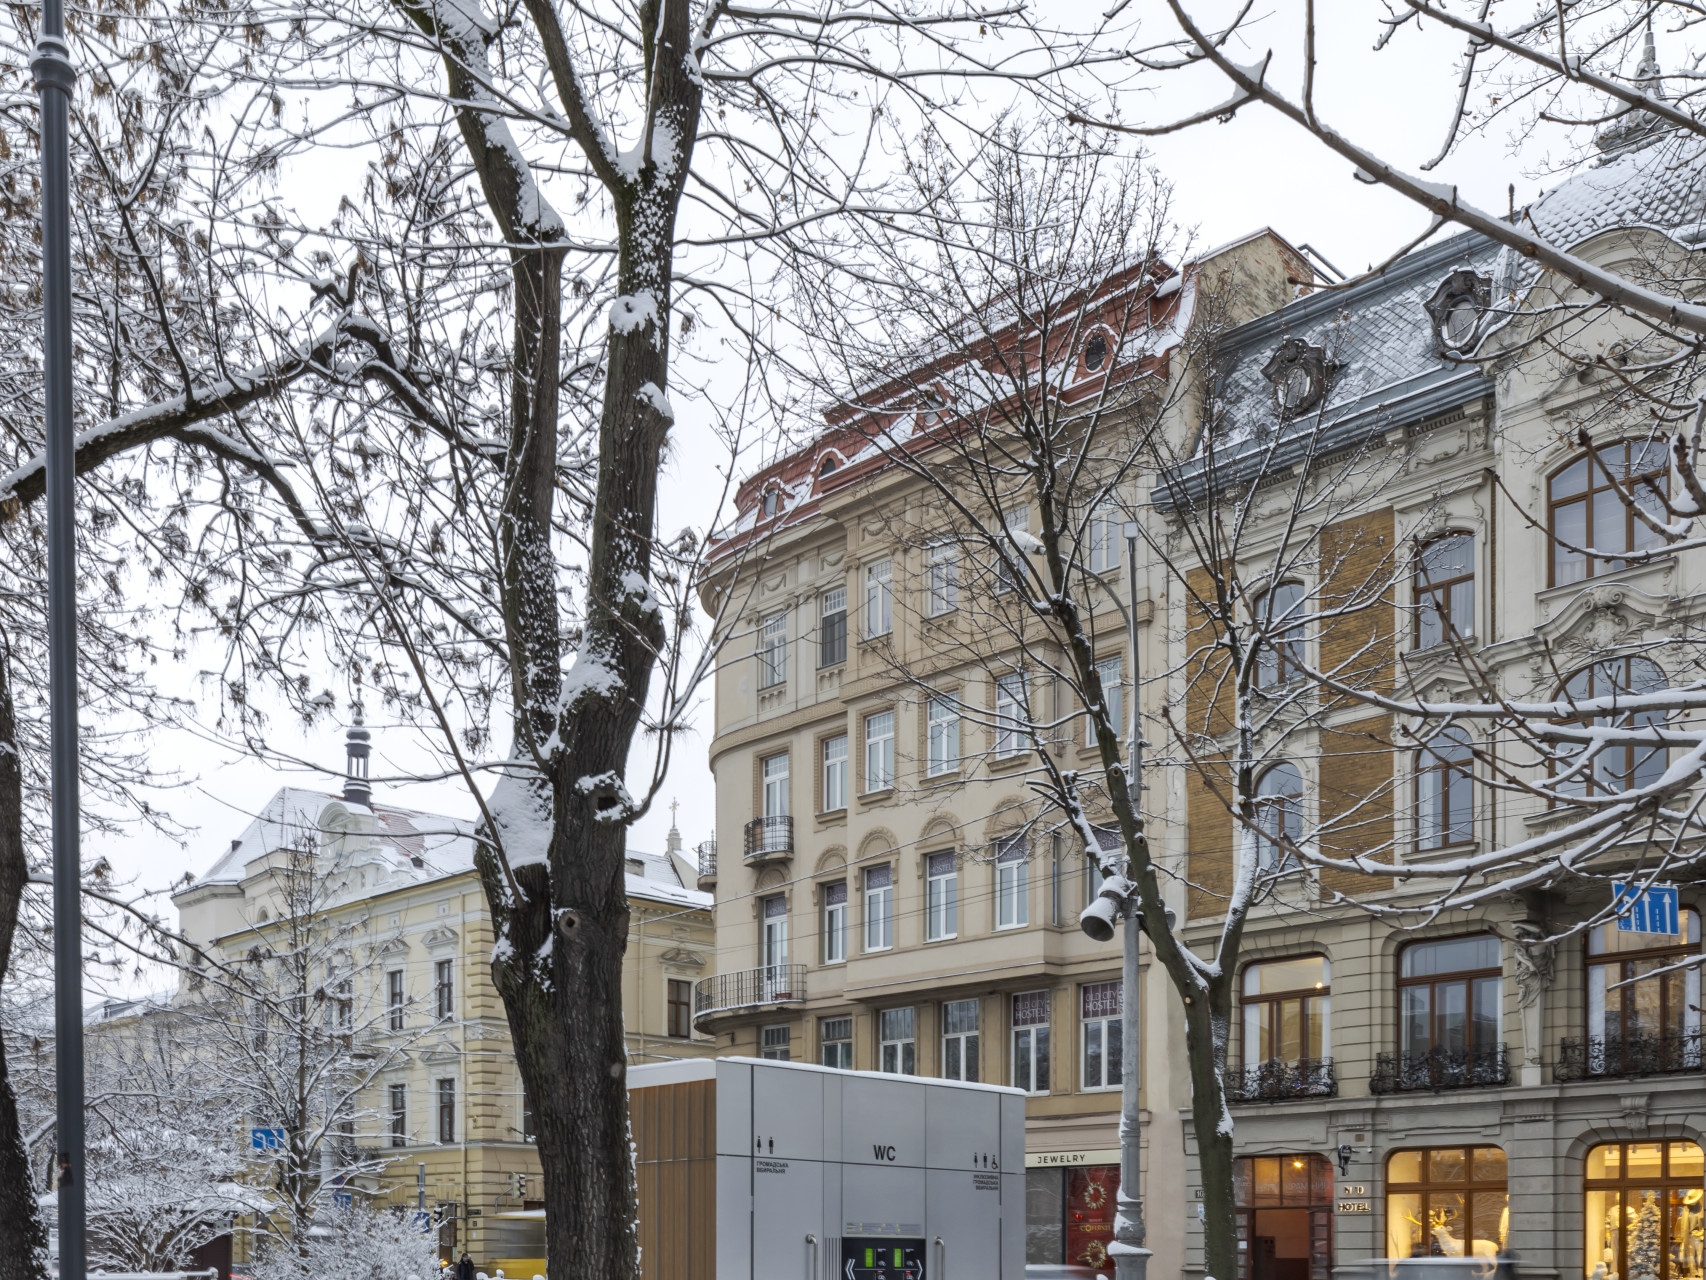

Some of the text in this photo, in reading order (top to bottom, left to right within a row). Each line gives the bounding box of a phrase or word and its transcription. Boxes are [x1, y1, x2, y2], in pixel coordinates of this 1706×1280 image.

[1086, 992, 1100, 1001] OLD
[1016, 1002, 1029, 1010] OLD
[1086, 999, 1117, 1012] HOSTEL
[1016, 1007, 1046, 1020] HOSTEL
[873, 1145, 896, 1161] WC
[1037, 1154, 1086, 1164] JEWELRY
[1338, 1202, 1371, 1212] HOTEL
